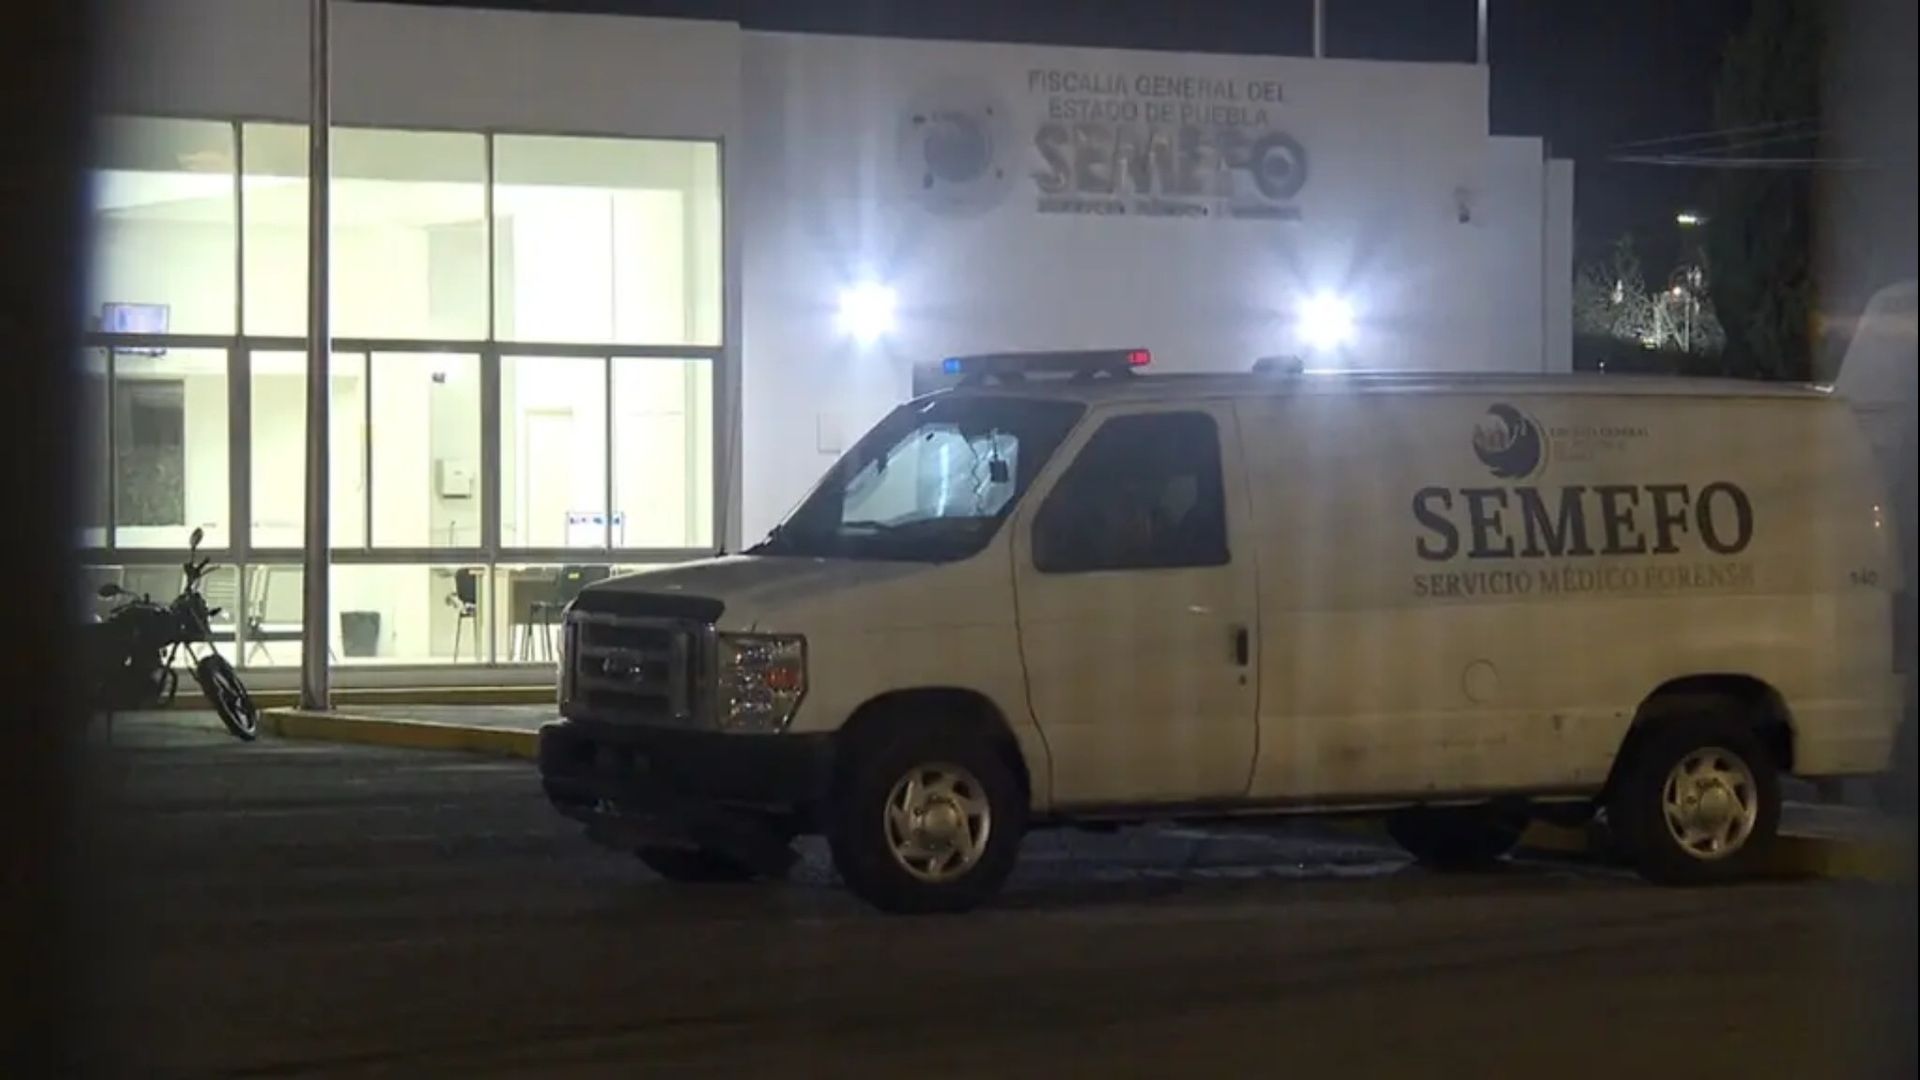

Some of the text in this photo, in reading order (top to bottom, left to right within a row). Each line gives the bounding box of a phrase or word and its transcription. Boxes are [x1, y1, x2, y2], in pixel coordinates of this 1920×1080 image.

[1135, 74, 1240, 102] GENERAL
[1247, 80, 1288, 103] DEL
[1049, 97, 1268, 126] ESTADO DE PUEBLA
[1033, 122, 1309, 200] SEMEFO
[1412, 481, 1754, 562] SEMEFO
[1413, 561, 1754, 598] SERVICIO MÉDICO FORENSE
